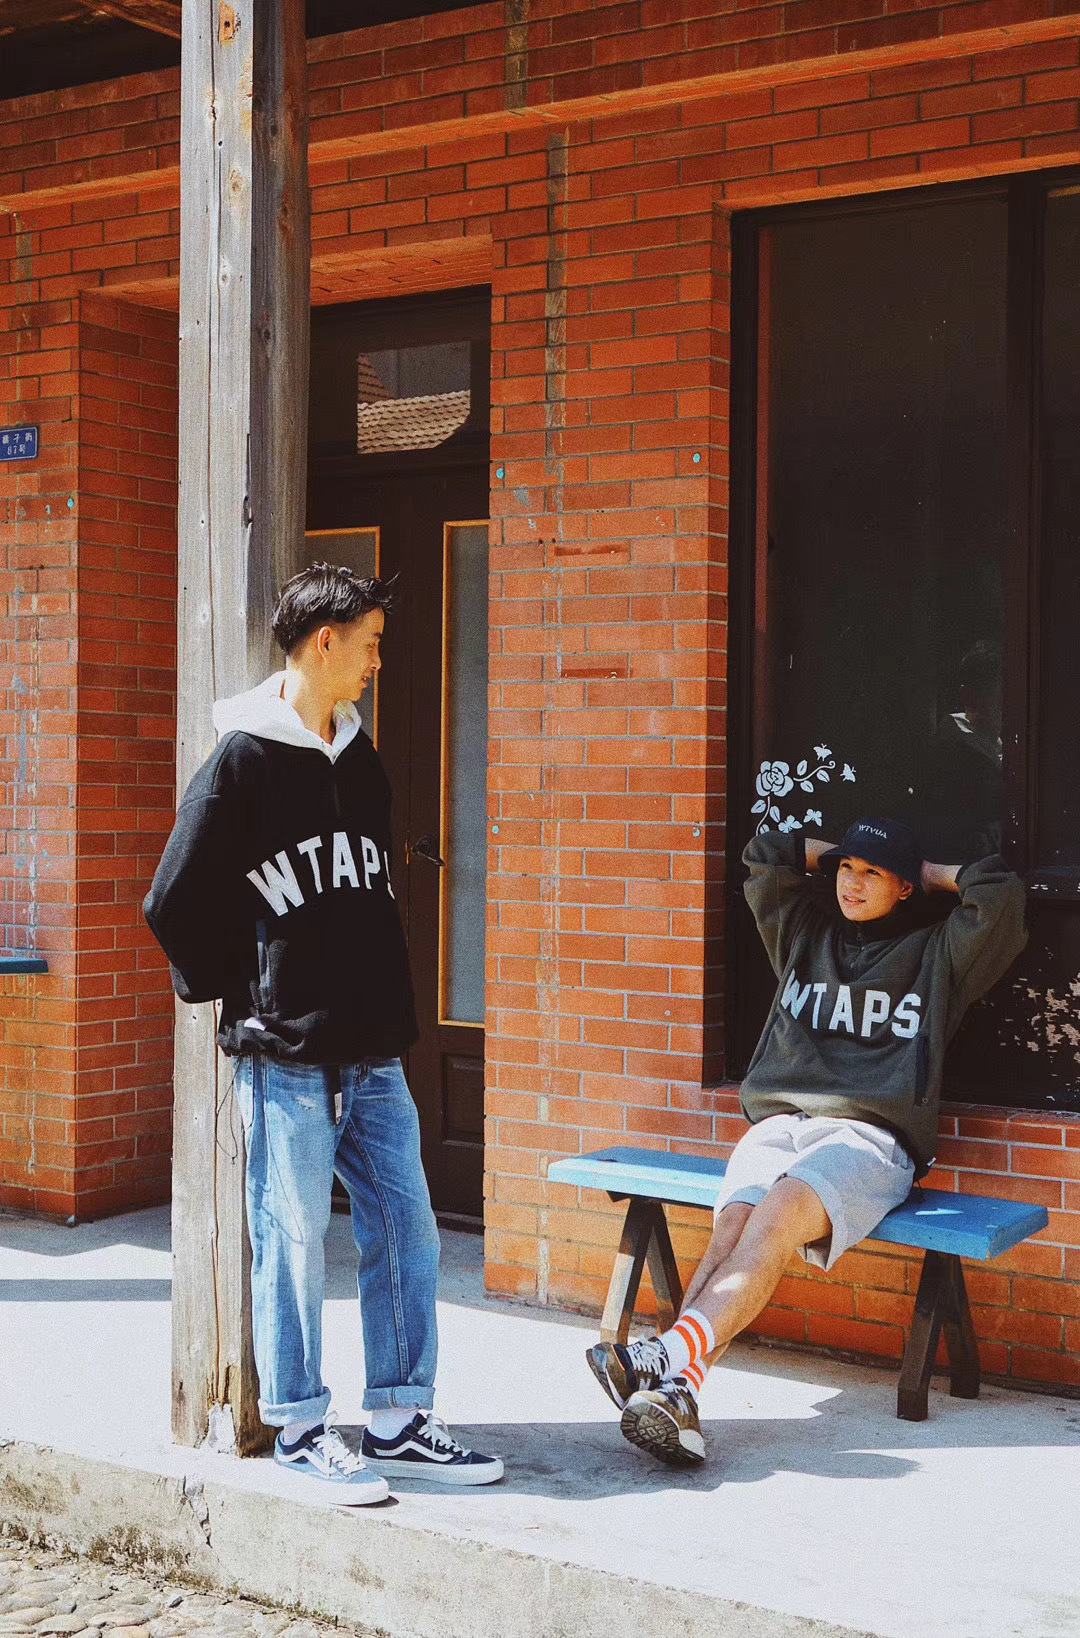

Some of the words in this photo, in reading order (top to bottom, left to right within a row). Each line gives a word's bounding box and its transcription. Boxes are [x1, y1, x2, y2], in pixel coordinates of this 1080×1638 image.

[7, 444, 26, 455] 87号
[246, 831, 396, 917] WTAP
[780, 967, 922, 1039] WTAPS
